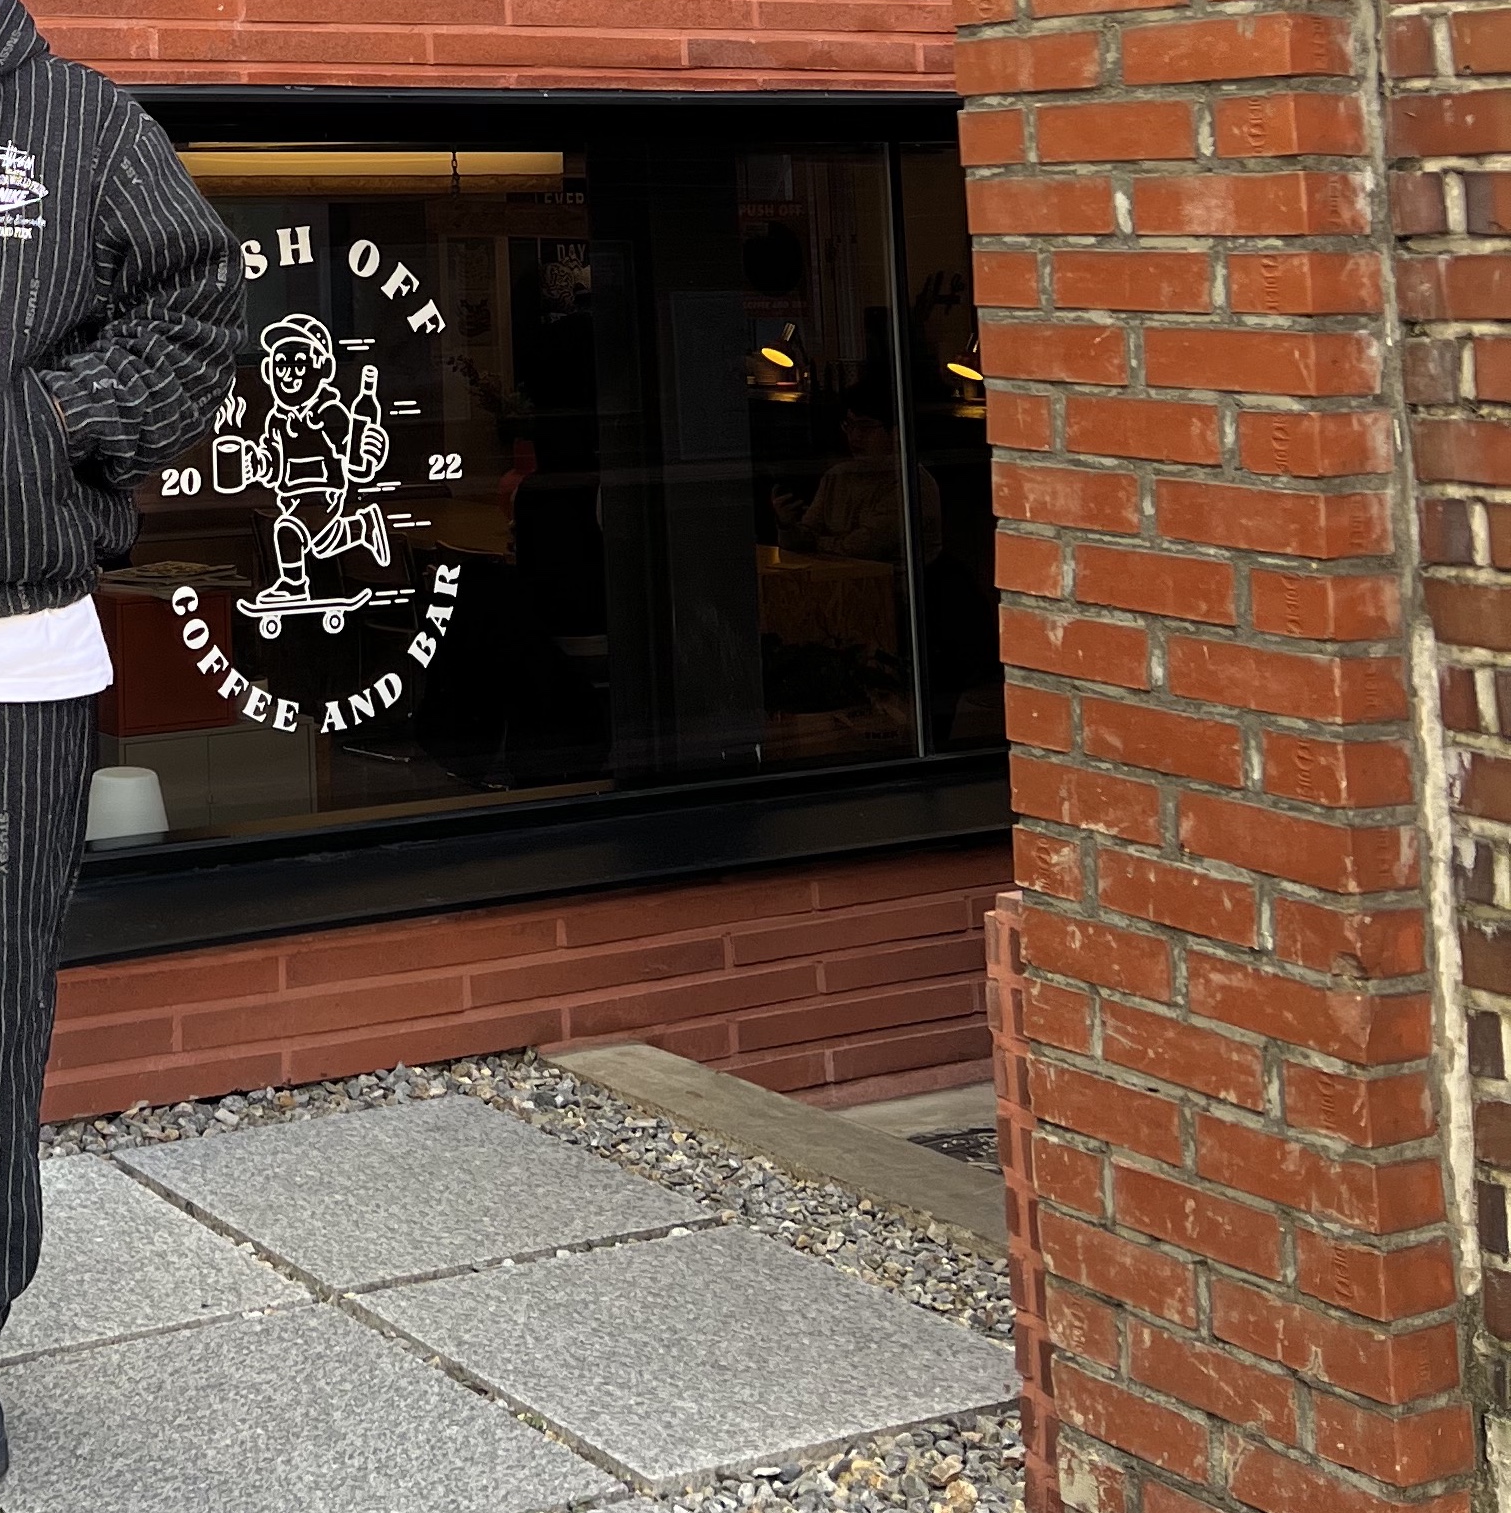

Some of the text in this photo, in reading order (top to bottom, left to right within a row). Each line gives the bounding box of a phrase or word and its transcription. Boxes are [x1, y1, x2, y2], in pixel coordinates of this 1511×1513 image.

[240, 226, 446, 333] SH OFF
[161, 453, 463, 496] 20 22
[172, 564, 461, 734] COFFEE AND BAR
[0, 810, 10, 875] STUSSY
